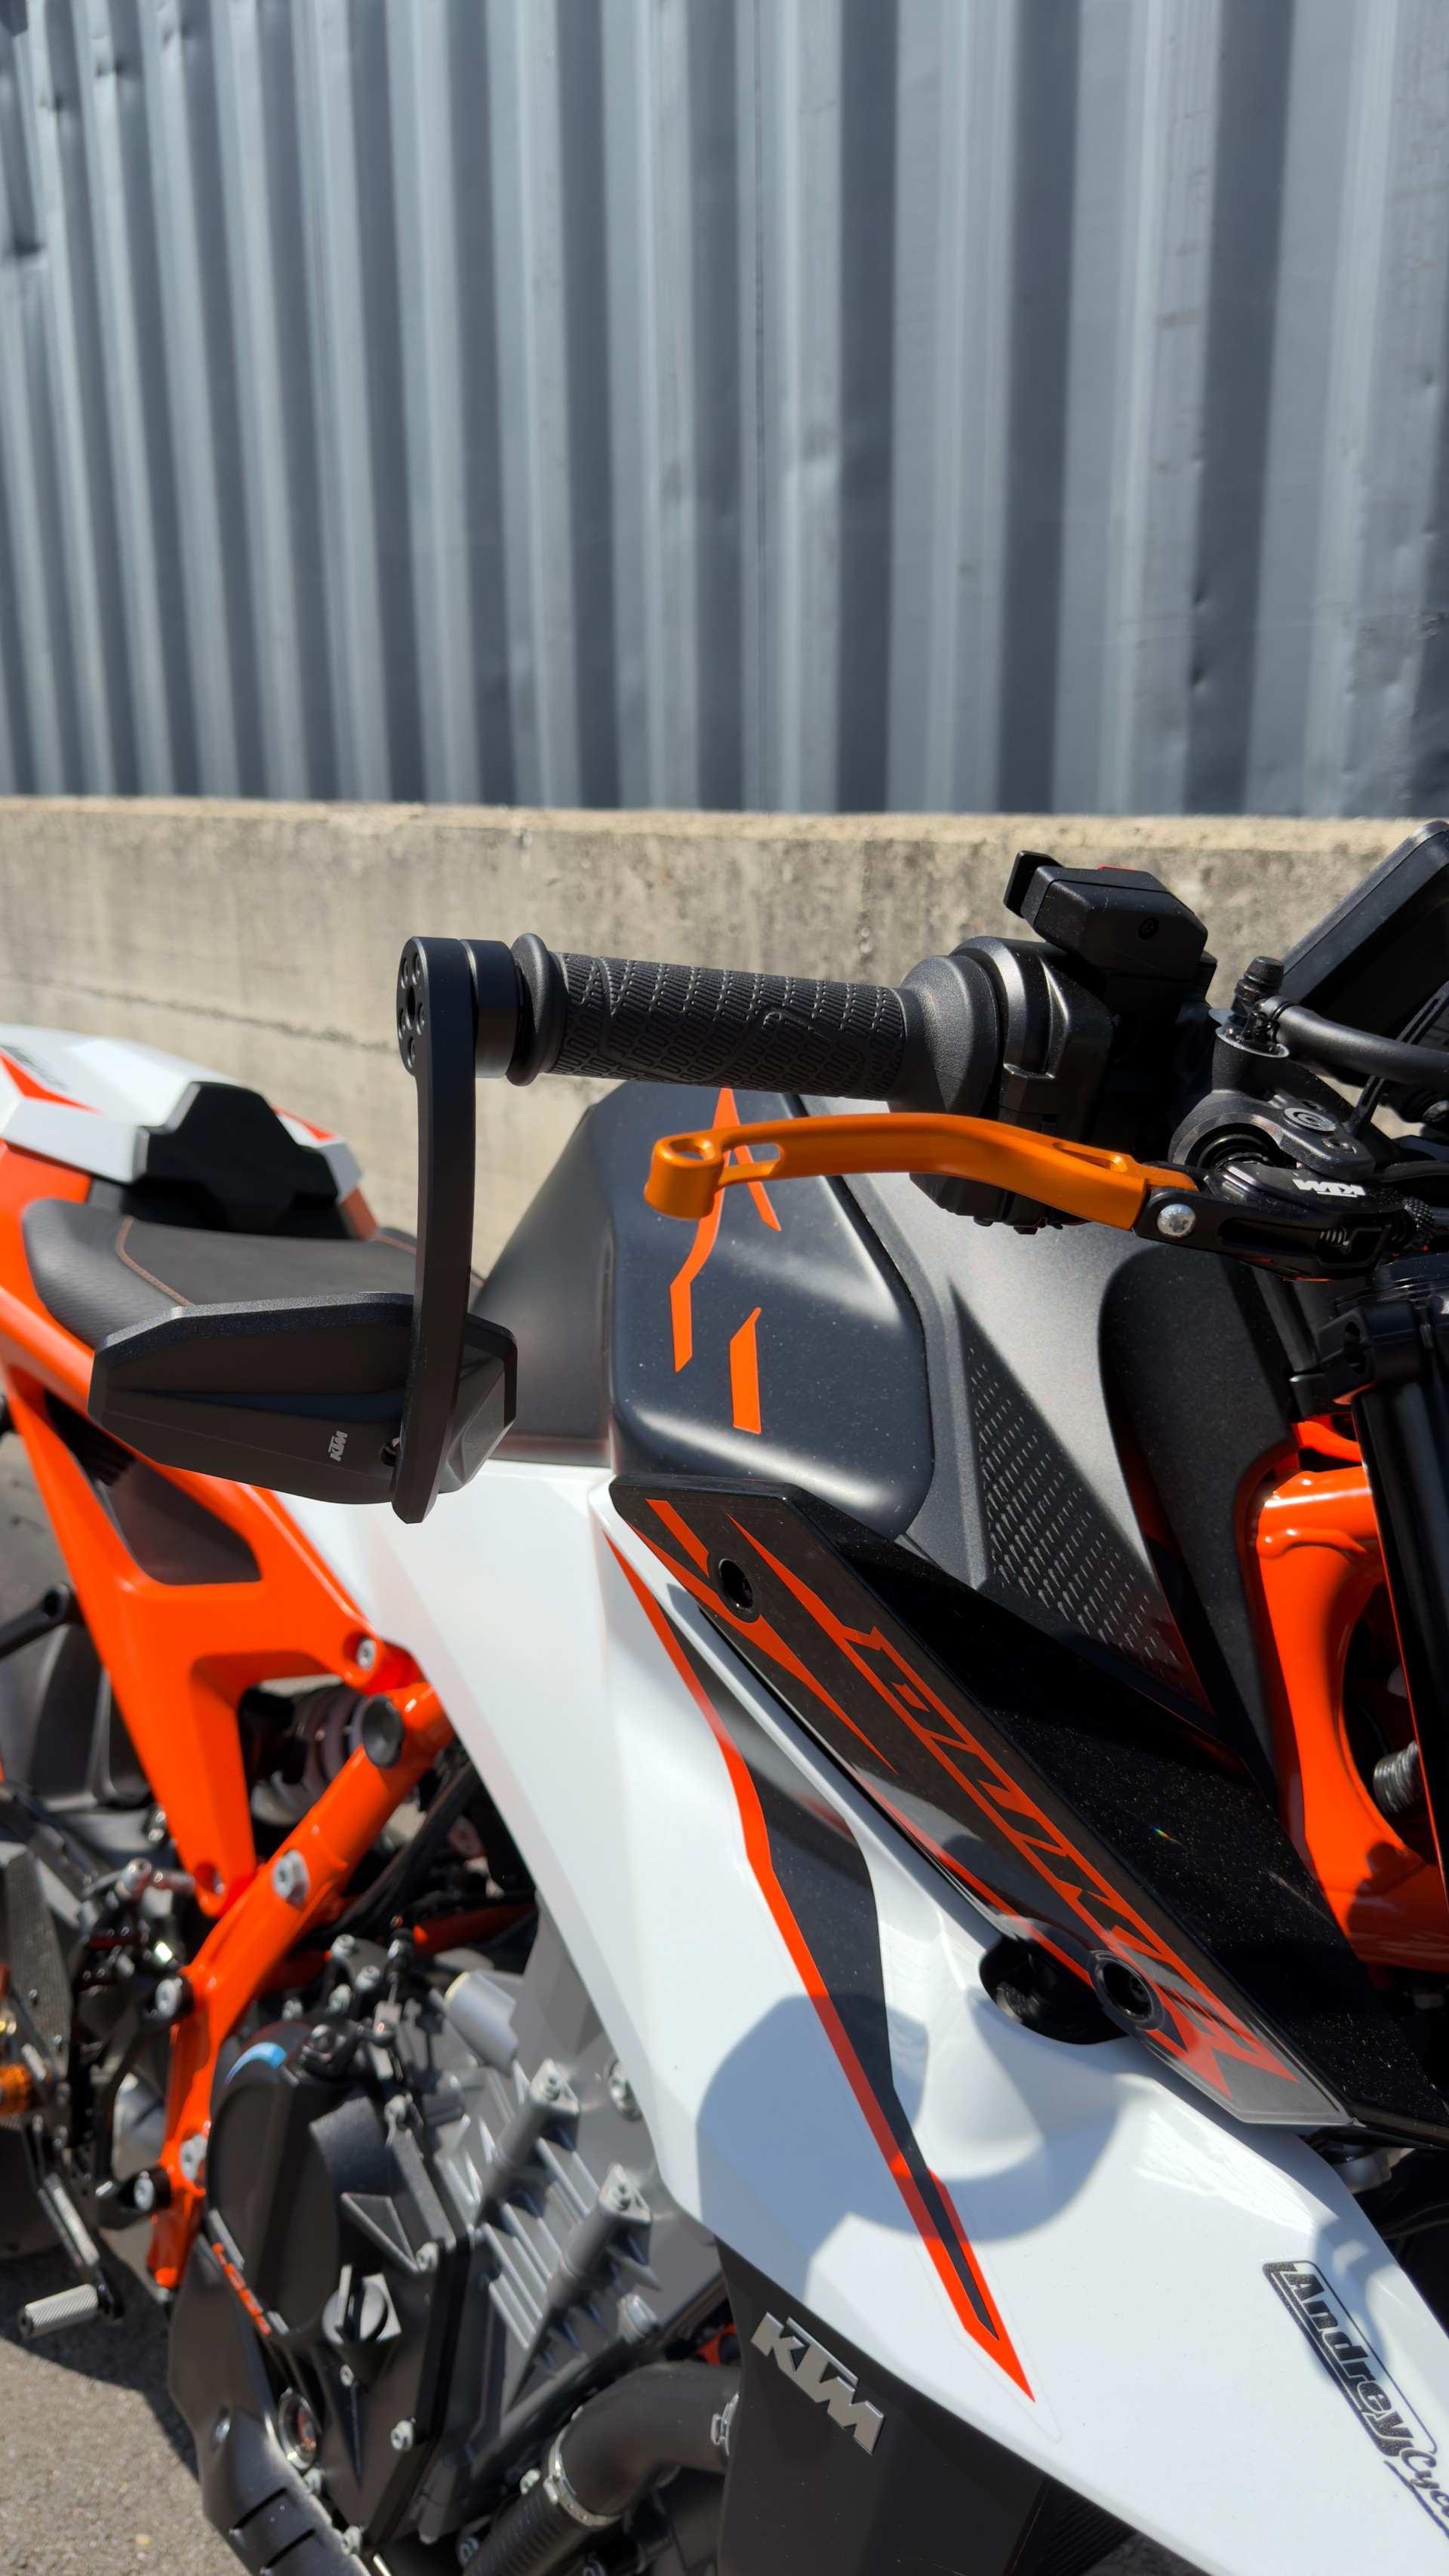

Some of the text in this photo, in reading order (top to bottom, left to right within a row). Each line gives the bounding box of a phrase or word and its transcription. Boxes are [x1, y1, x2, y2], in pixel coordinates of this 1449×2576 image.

[1291, 1178, 1367, 1199] KTM
[328, 1430, 348, 1462] KTM
[843, 1635, 1259, 2055] DUKE
[750, 2311, 884, 2454] KTM
[1281, 2270, 1415, 2446] Andrey
